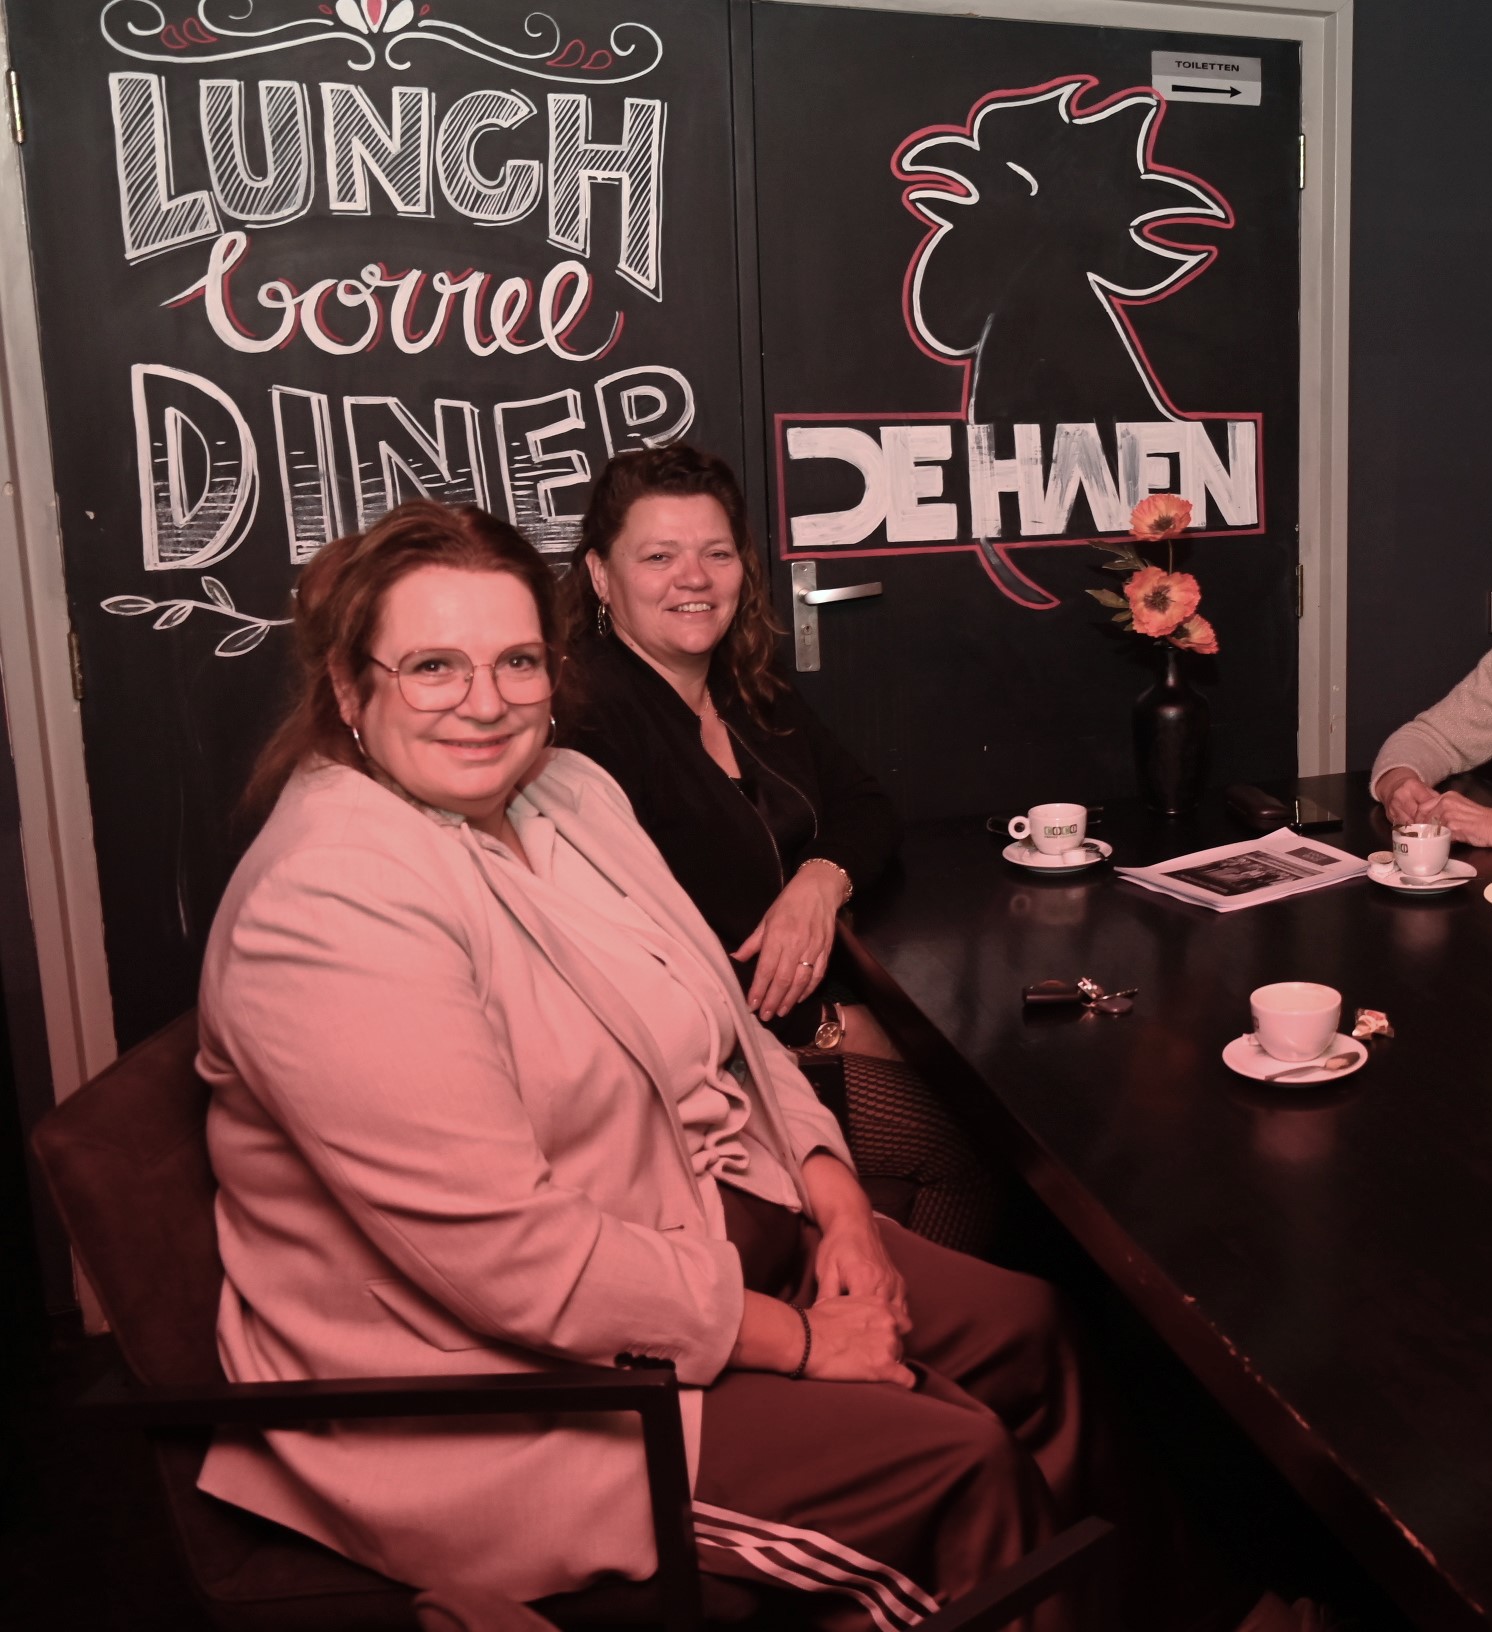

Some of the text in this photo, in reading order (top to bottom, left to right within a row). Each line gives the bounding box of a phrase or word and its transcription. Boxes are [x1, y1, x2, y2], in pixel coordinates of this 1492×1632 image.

[1174, 60, 1240, 73] TOILETTEN
[109, 72, 667, 302] LUNCH
[786, 425, 959, 547] DE
